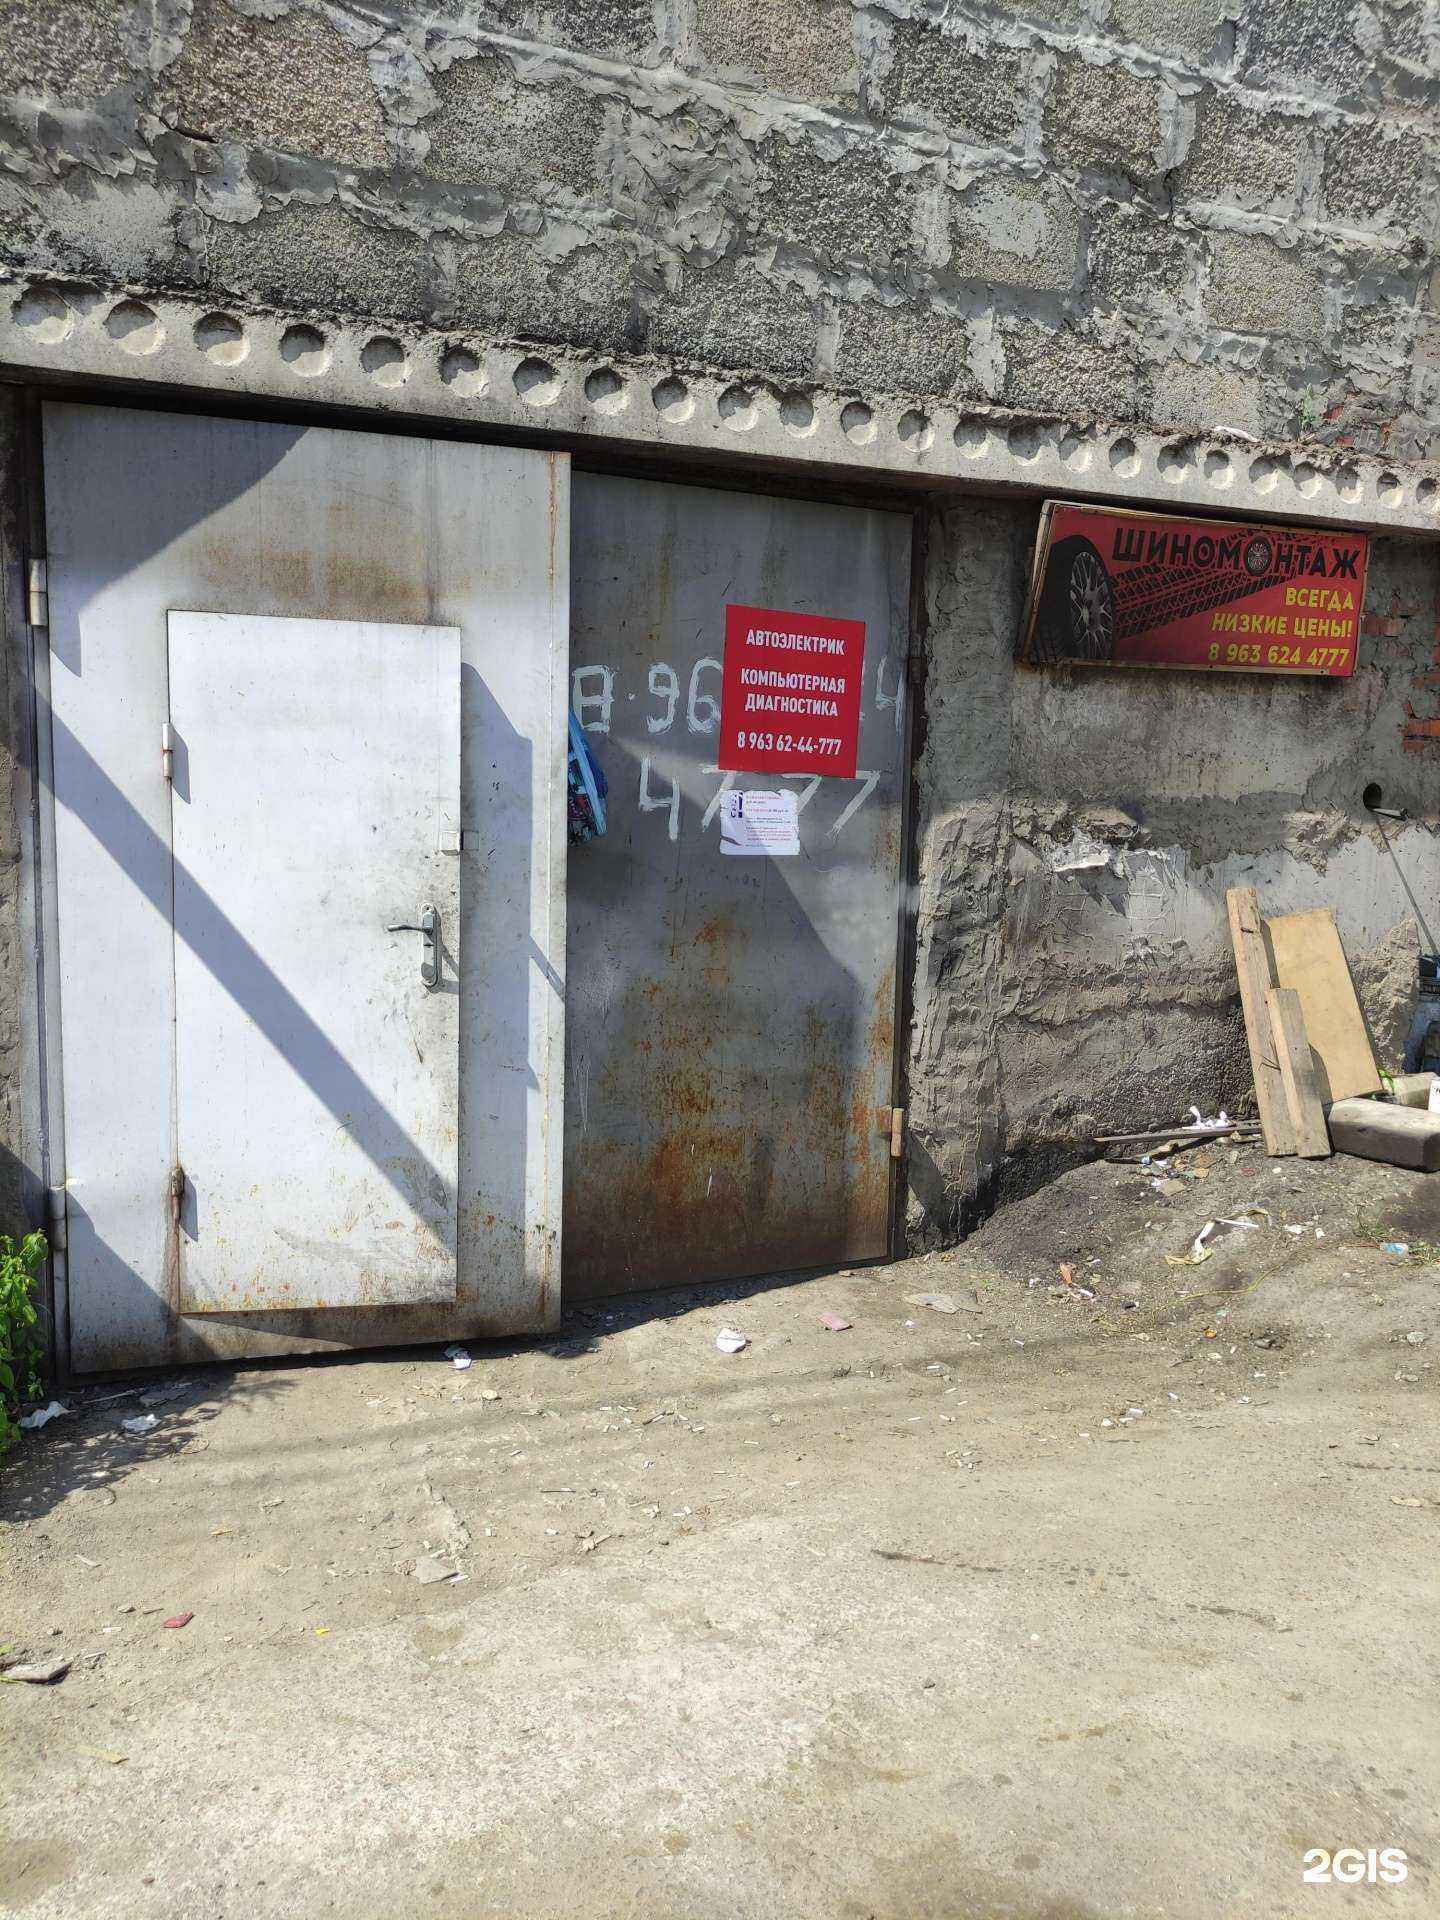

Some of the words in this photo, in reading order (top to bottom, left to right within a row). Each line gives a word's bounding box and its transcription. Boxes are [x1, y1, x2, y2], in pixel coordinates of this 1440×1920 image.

[1111, 527, 1361, 580] ШИНОМОНТАЖ
[1285, 587, 1354, 612] ВСЕГДА
[1211, 612, 1288, 635] НИЗКИЕ
[1293, 617, 1353, 638] ЦЕНЫ!
[745, 628, 846, 656] АВТОЭЛЕКТРИК
[1208, 642, 1220, 662] 8
[1226, 643, 1262, 663] 963
[1267, 645, 1301, 665] 624
[1306, 647, 1350, 667] 4777
[740, 668, 847, 694] КОМПЬЮТЕРНАЯ
[744, 692, 839, 717] ДИАГНОСТИКА
[737, 731, 746, 749] 8
[749, 731, 774, 751] 963
[776, 734, 842, 756] 62-44-777
